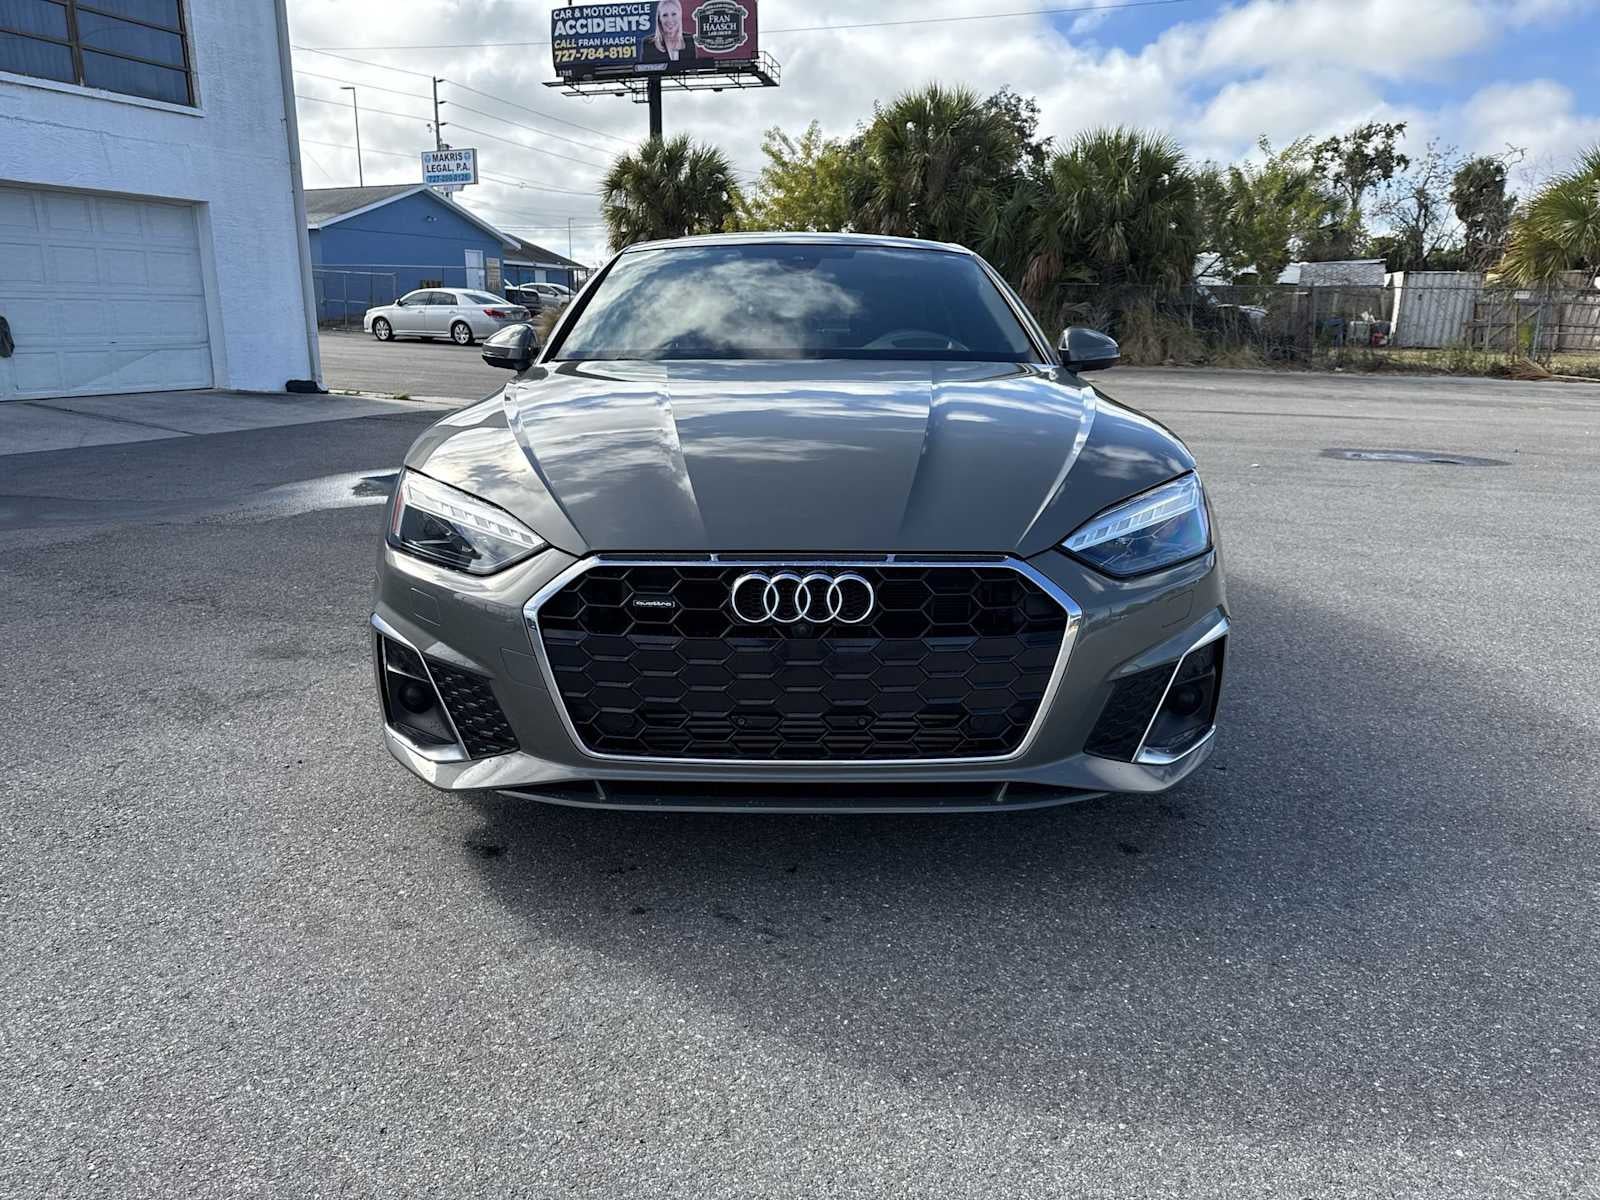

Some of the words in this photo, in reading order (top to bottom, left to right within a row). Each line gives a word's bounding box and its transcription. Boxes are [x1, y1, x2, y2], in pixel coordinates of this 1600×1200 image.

[553, 8, 572, 20] CAR
[574, 8, 581, 17] &
[583, 4, 651, 17] MOTORCYCLE
[709, 15, 730, 23] FRAN
[554, 15, 651, 36] ACCIDENTS
[703, 23, 737, 31] HAASCH
[554, 39, 577, 49] CALL
[578, 38, 600, 47] FRAN
[602, 36, 636, 45] HAASCH
[555, 46, 637, 62] 727-784-8191
[432, 152, 463, 162] MAKRIS
[426, 163, 454, 173] LEGAL,
[456, 163, 470, 172] P.A.
